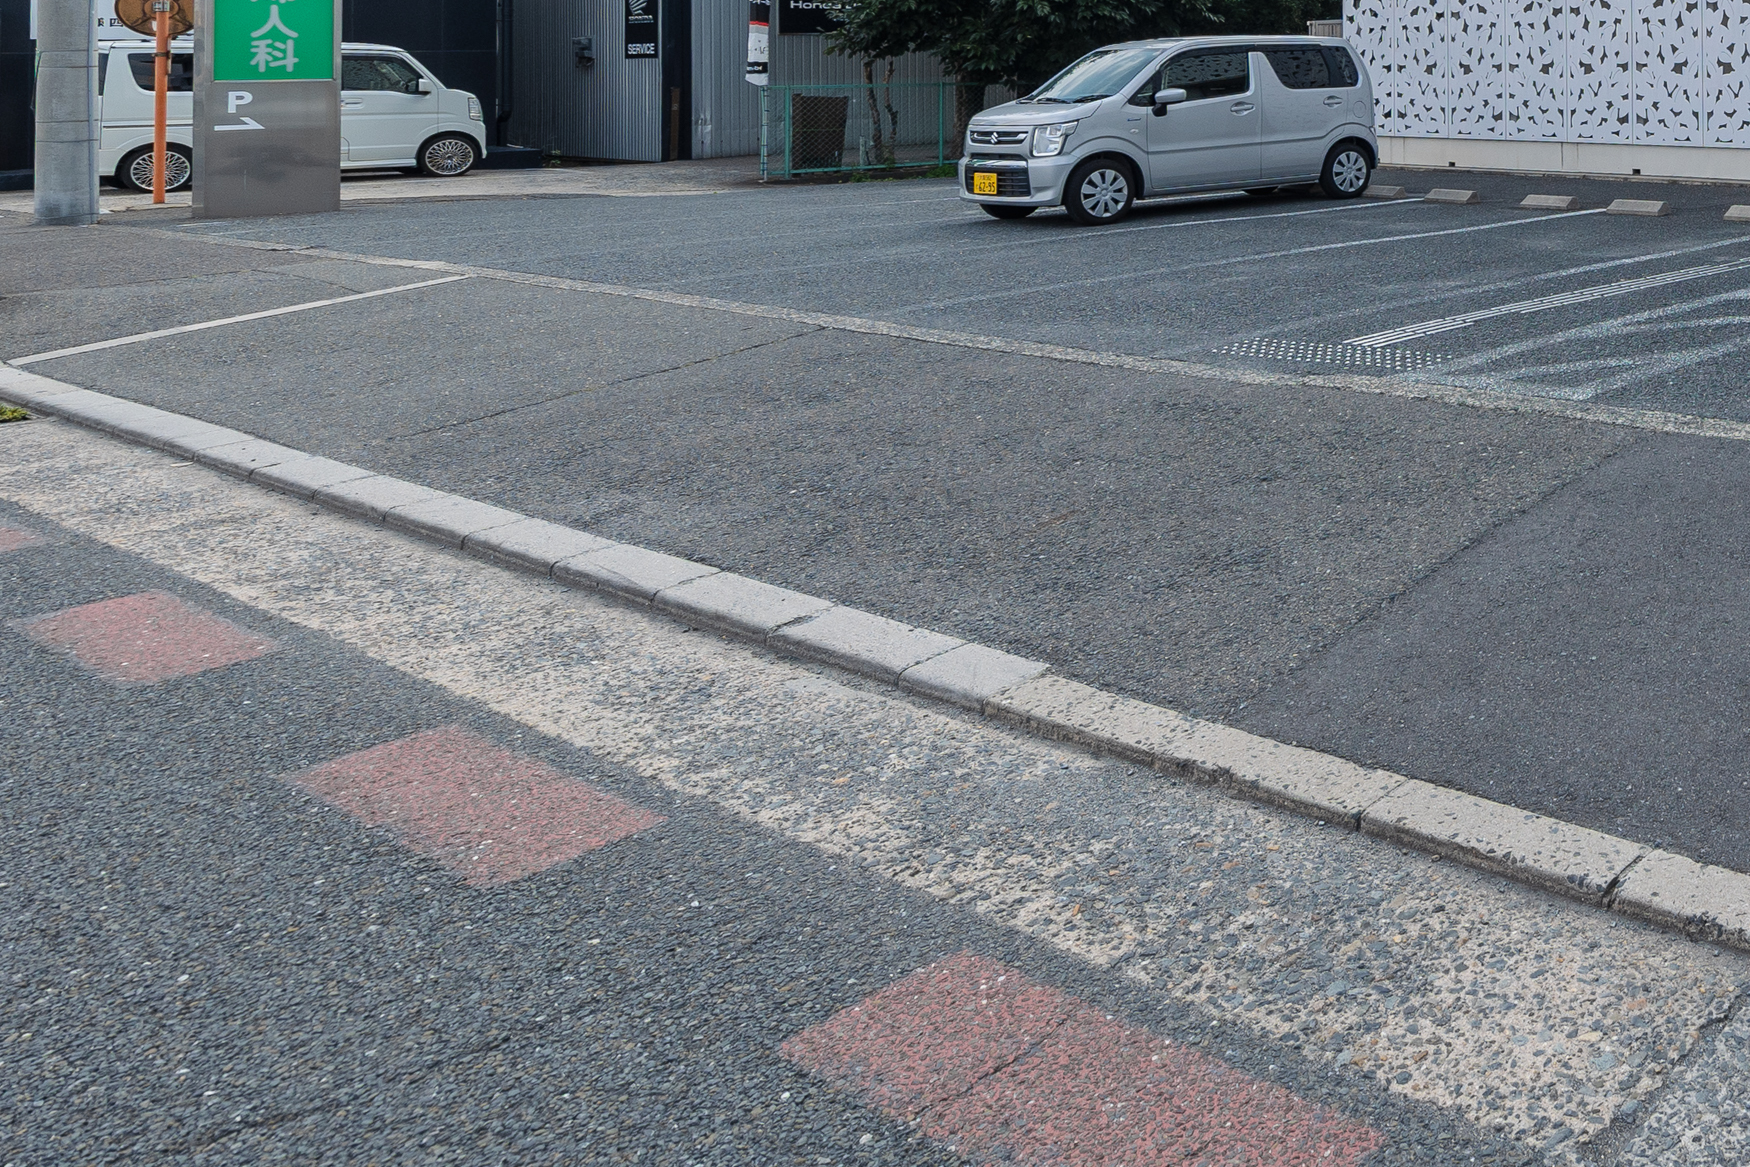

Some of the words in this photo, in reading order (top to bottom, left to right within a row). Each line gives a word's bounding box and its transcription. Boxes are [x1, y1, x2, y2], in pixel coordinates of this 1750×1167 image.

[627, 43, 656, 55] SERVICE
[227, 91, 253, 114] P
[978, 182, 995, 192] 62-95
